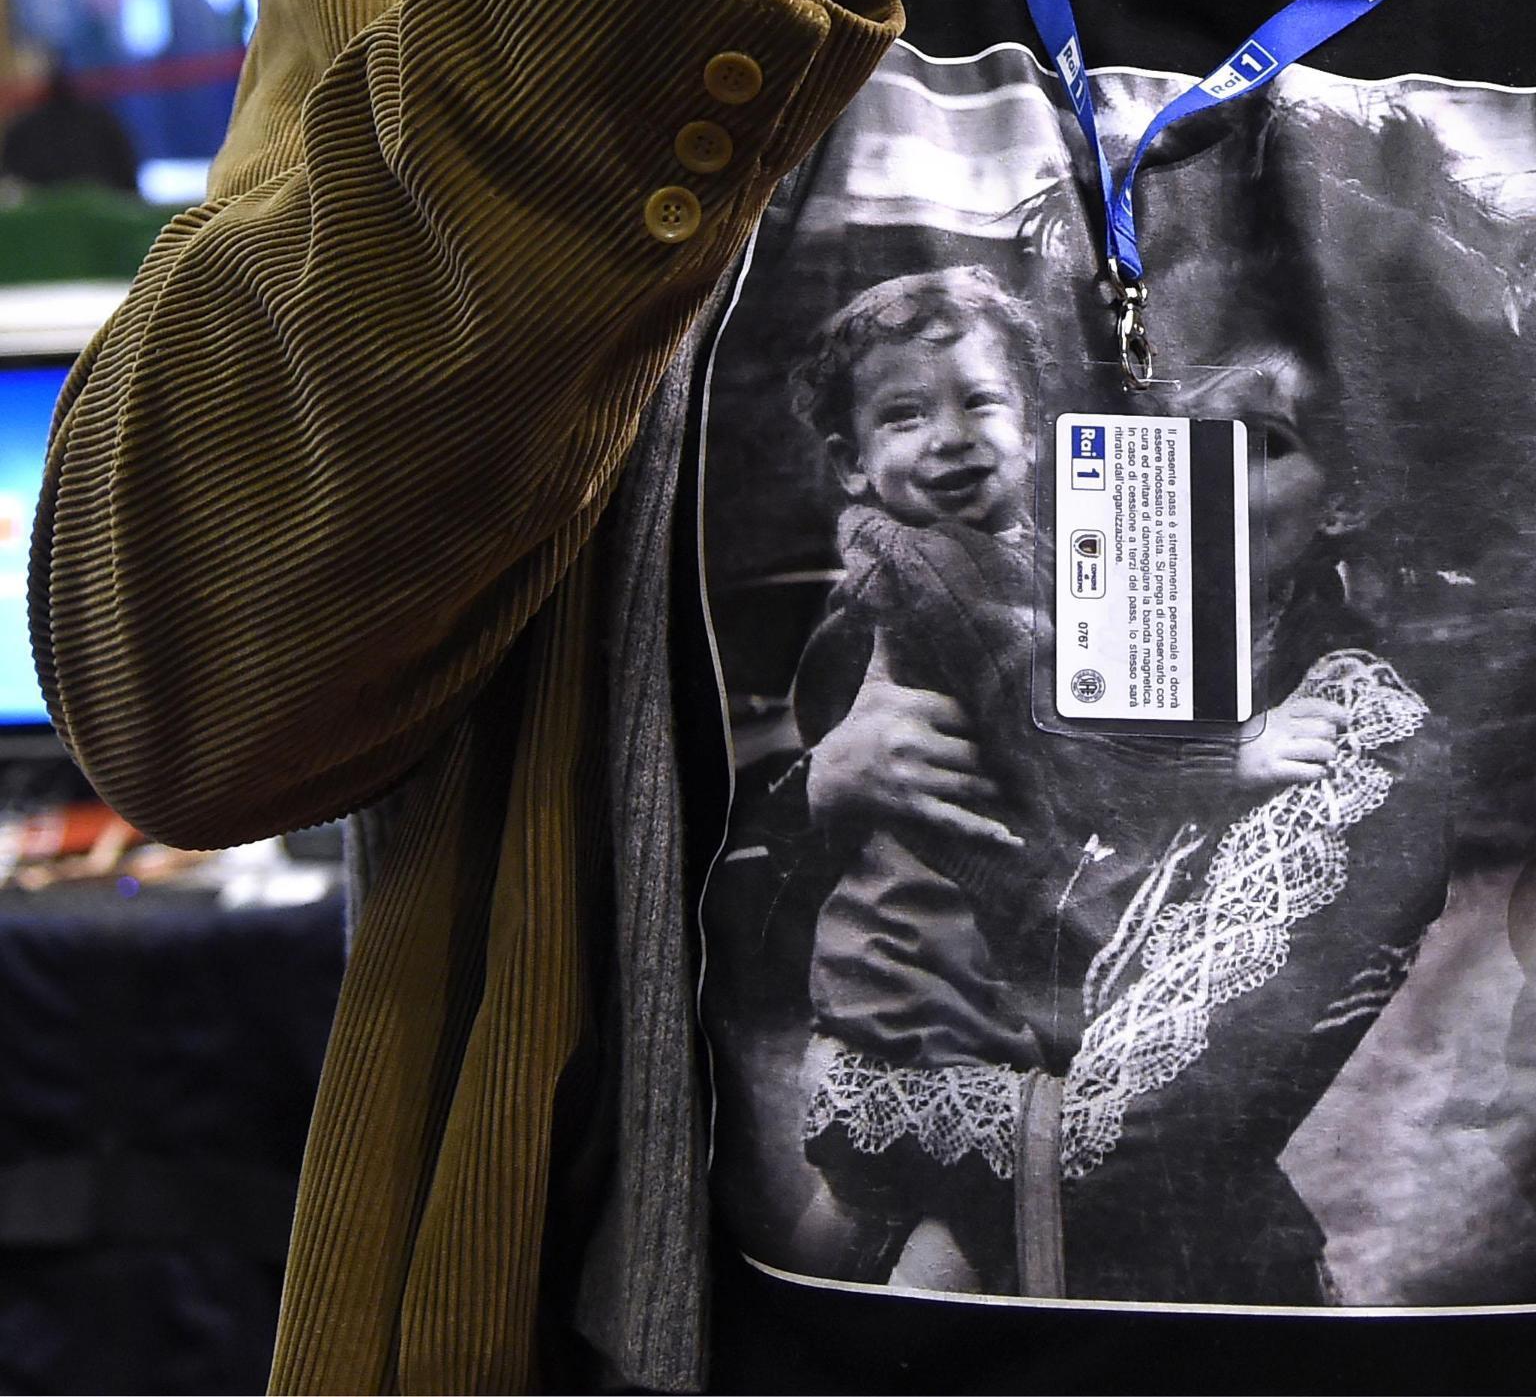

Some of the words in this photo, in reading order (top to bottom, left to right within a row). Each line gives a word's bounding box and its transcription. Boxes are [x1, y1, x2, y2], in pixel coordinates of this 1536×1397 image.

[1063, 45, 1078, 77] Rai
[1075, 78, 1084, 100] 1
[1210, 72, 1242, 94] Rai
[1241, 53, 1263, 72] 1
[1080, 428, 1097, 457] Rai
[1114, 426, 1125, 460] ritirato
[1127, 427, 1138, 437] In
[1141, 428, 1150, 451] cura
[1153, 428, 1163, 462] essere
[1127, 441, 1137, 467] caso
[1141, 455, 1152, 468] ed
[1165, 440, 1177, 486] presente
[1076, 468, 1100, 479] 1
[1127, 471, 1139, 481] di
[1141, 473, 1151, 508] evitare
[1154, 466, 1165, 516] indossato
[1166, 491, 1177, 516] pass
[1112, 462, 1126, 566] dall'organizzazione.
[1127, 485, 1138, 532] cessione
[1141, 512, 1152, 522] di
[1155, 530, 1165, 557] vista.
[1128, 548, 1140, 570] terzi
[1139, 526, 1153, 592] danneggiare
[1155, 562, 1167, 571] Si
[1168, 534, 1179, 601] strettamente
[1128, 575, 1139, 592] del
[1153, 575, 1165, 605] prega
[1127, 596, 1138, 624] pass,
[1142, 596, 1153, 605] la
[1155, 609, 1167, 618] di
[1129, 630, 1140, 640] lo
[1142, 610, 1153, 644] banda
[1167, 607, 1180, 660] personale
[1129, 644, 1139, 680] stesso
[1155, 622, 1167, 684] conservarlo
[1140, 648, 1153, 707] magnetica.
[1129, 684, 1140, 708] sarà
[1156, 688, 1165, 708] con
[1169, 678, 1181, 708] dovrà
